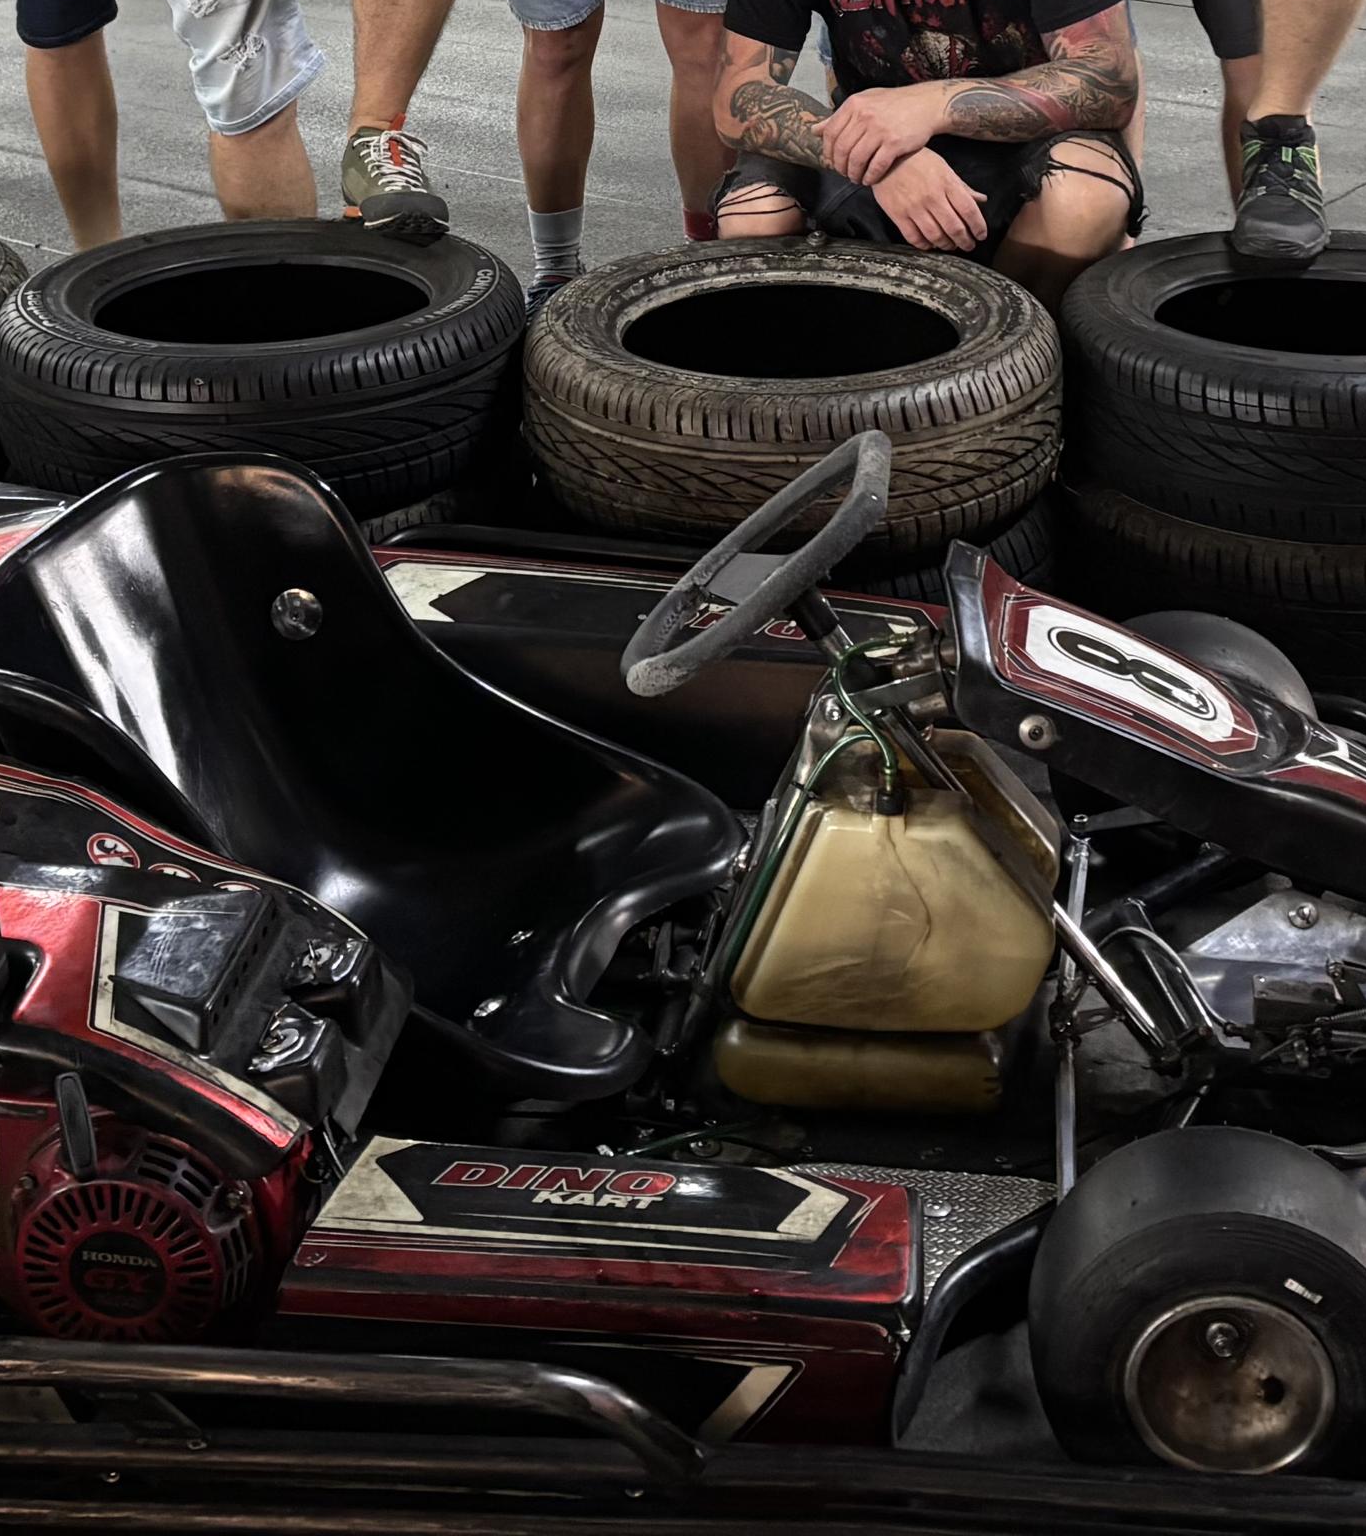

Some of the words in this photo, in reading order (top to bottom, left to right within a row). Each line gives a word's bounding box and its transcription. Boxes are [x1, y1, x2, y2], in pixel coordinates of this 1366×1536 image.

[1050, 628, 1215, 719] 8
[431, 1161, 677, 1196] DINO
[532, 1190, 664, 1209] KART
[82, 1250, 158, 1268] HONDA
